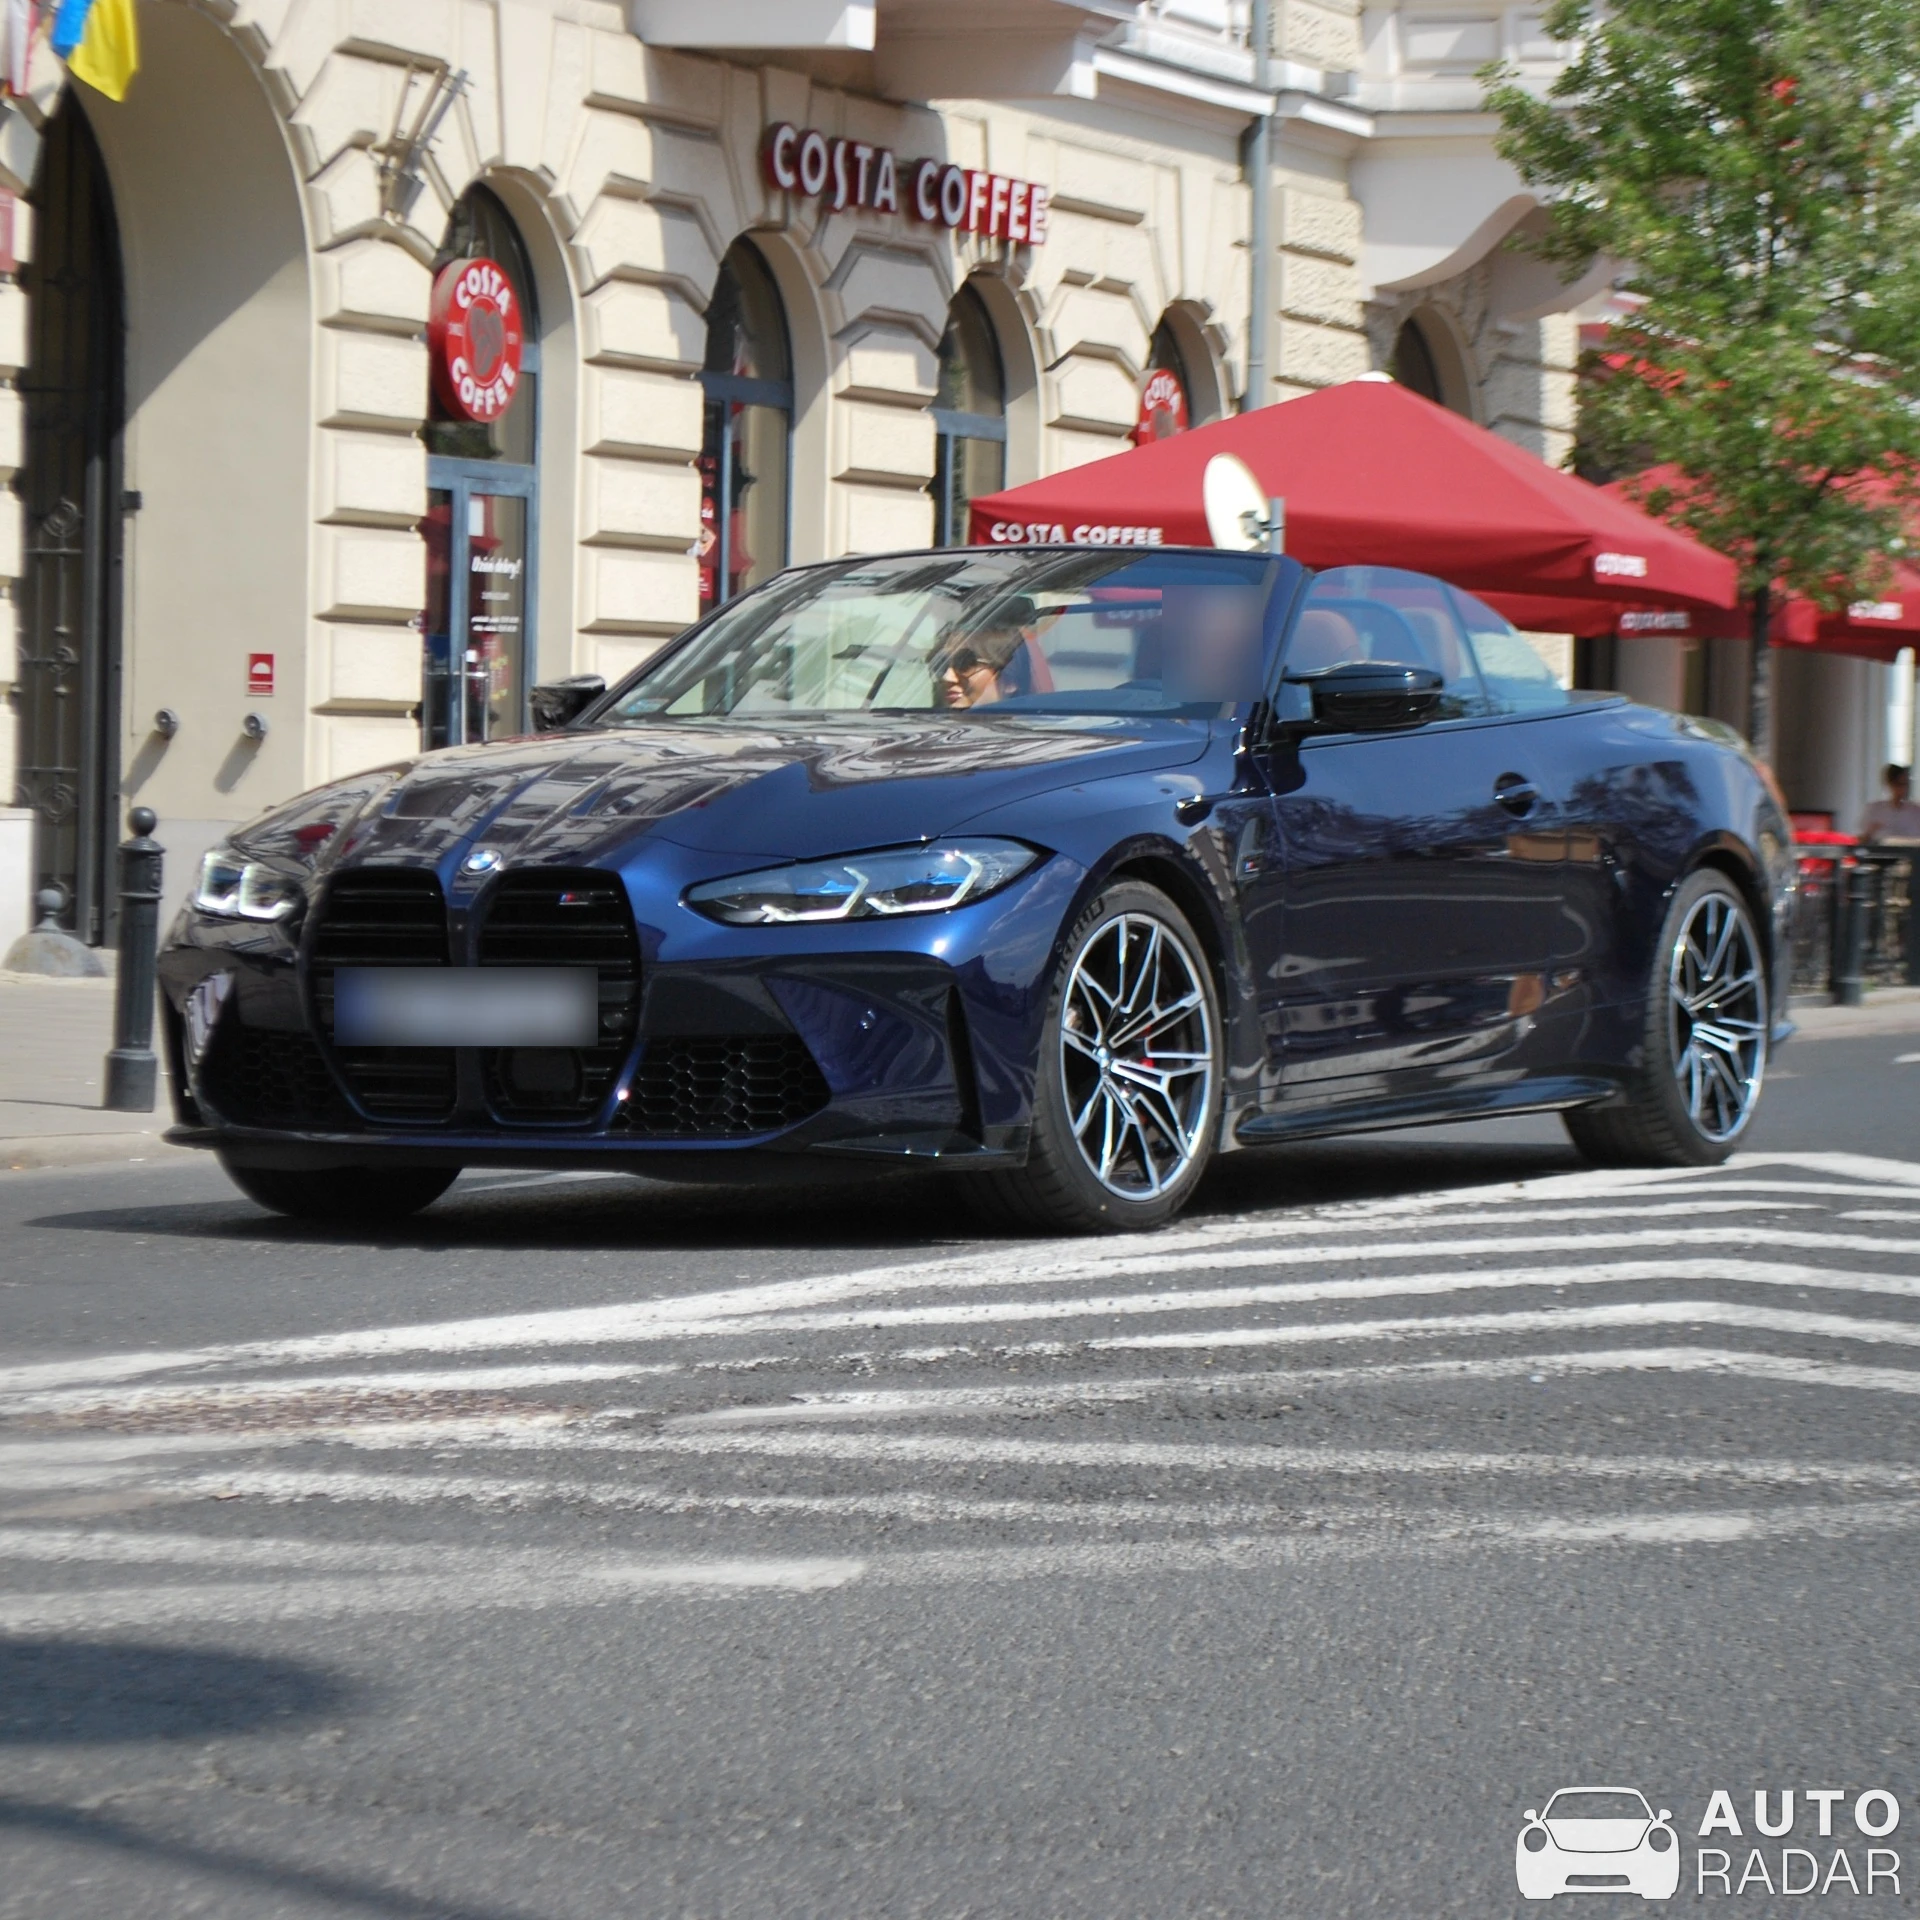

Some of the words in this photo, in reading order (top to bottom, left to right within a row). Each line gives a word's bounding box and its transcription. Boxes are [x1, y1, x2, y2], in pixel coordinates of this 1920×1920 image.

[770, 123, 897, 212] COSTA
[913, 157, 1048, 246] COFFEE
[456, 265, 512, 316] COSTA
[451, 356, 516, 415] COFFEE
[1144, 374, 1182, 415] COSTA
[990, 522, 1066, 544] COSTA
[1073, 525, 1163, 545] COFFEE
